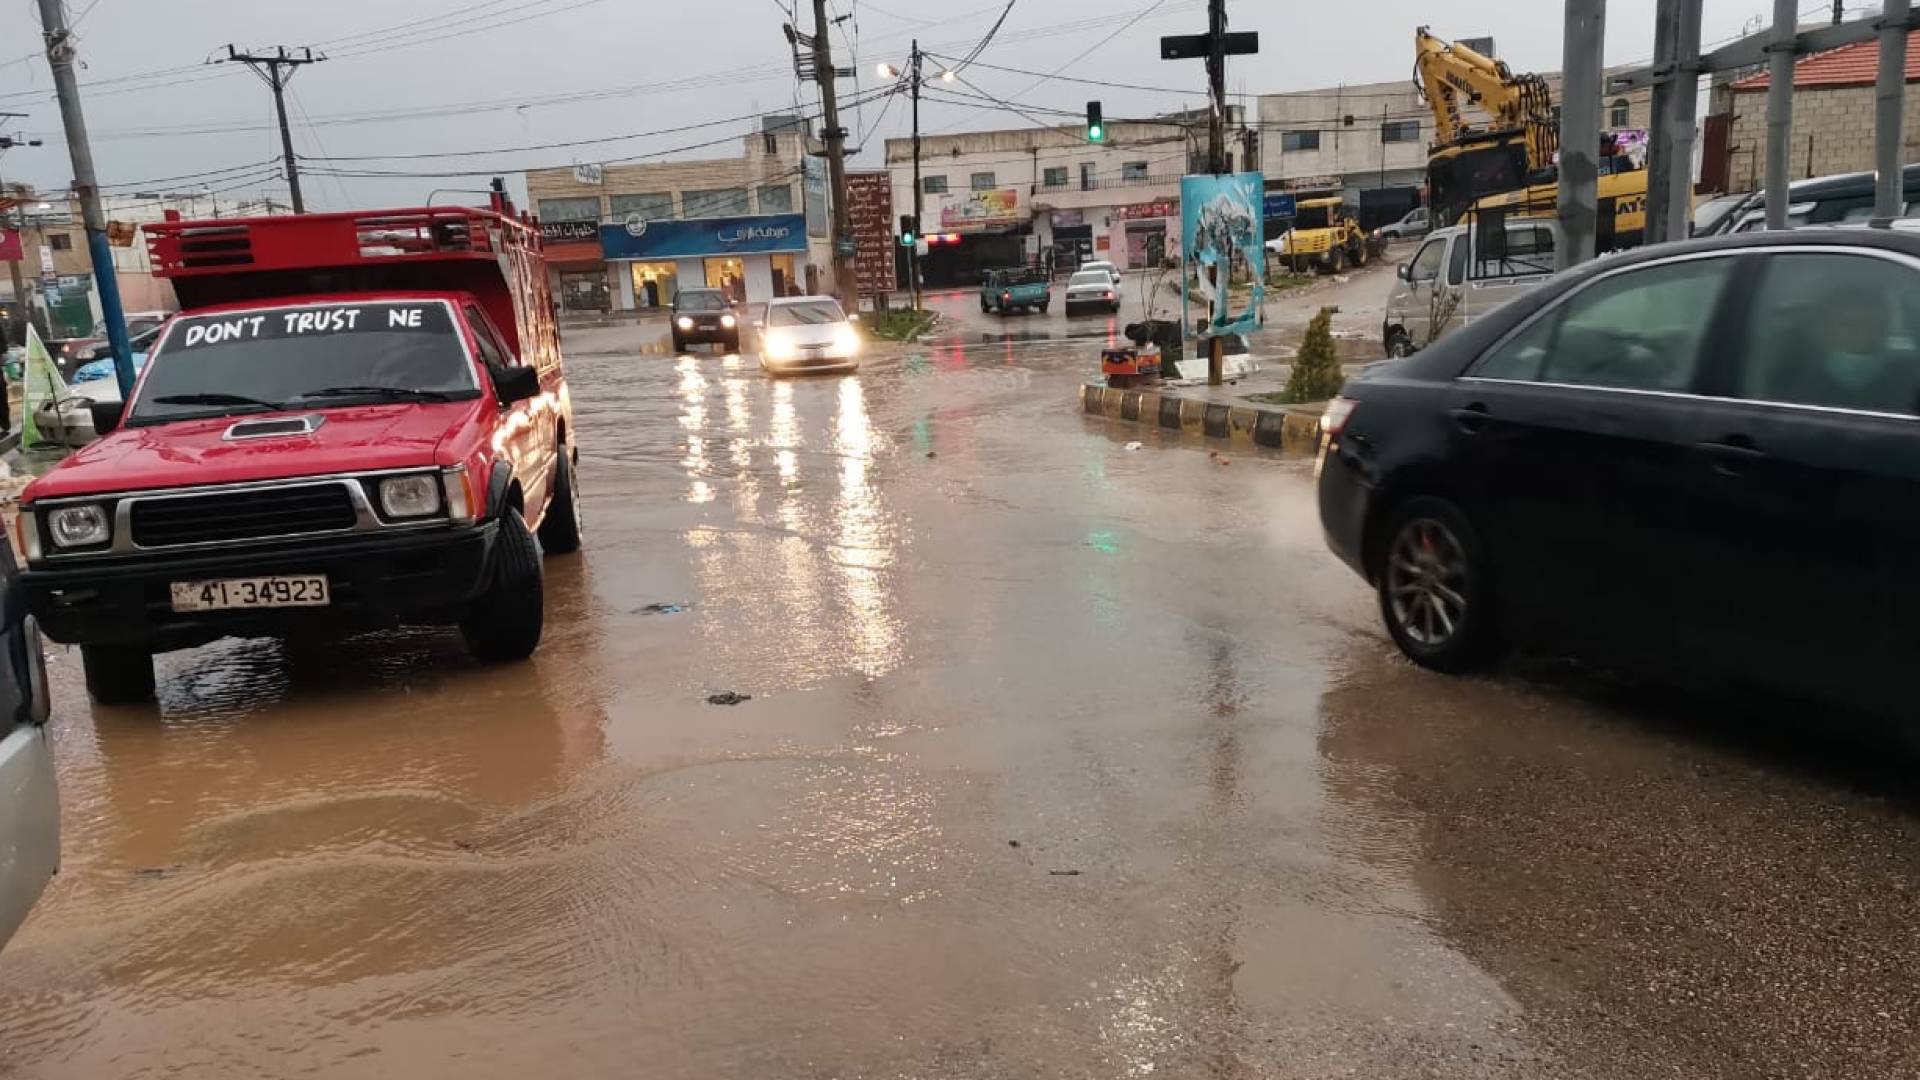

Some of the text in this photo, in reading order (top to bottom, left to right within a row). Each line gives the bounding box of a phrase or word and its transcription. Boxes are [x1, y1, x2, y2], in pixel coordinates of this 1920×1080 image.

[185, 308, 423, 347] DON'T TRUST NE
[201, 578, 325, 607] 41-34923
